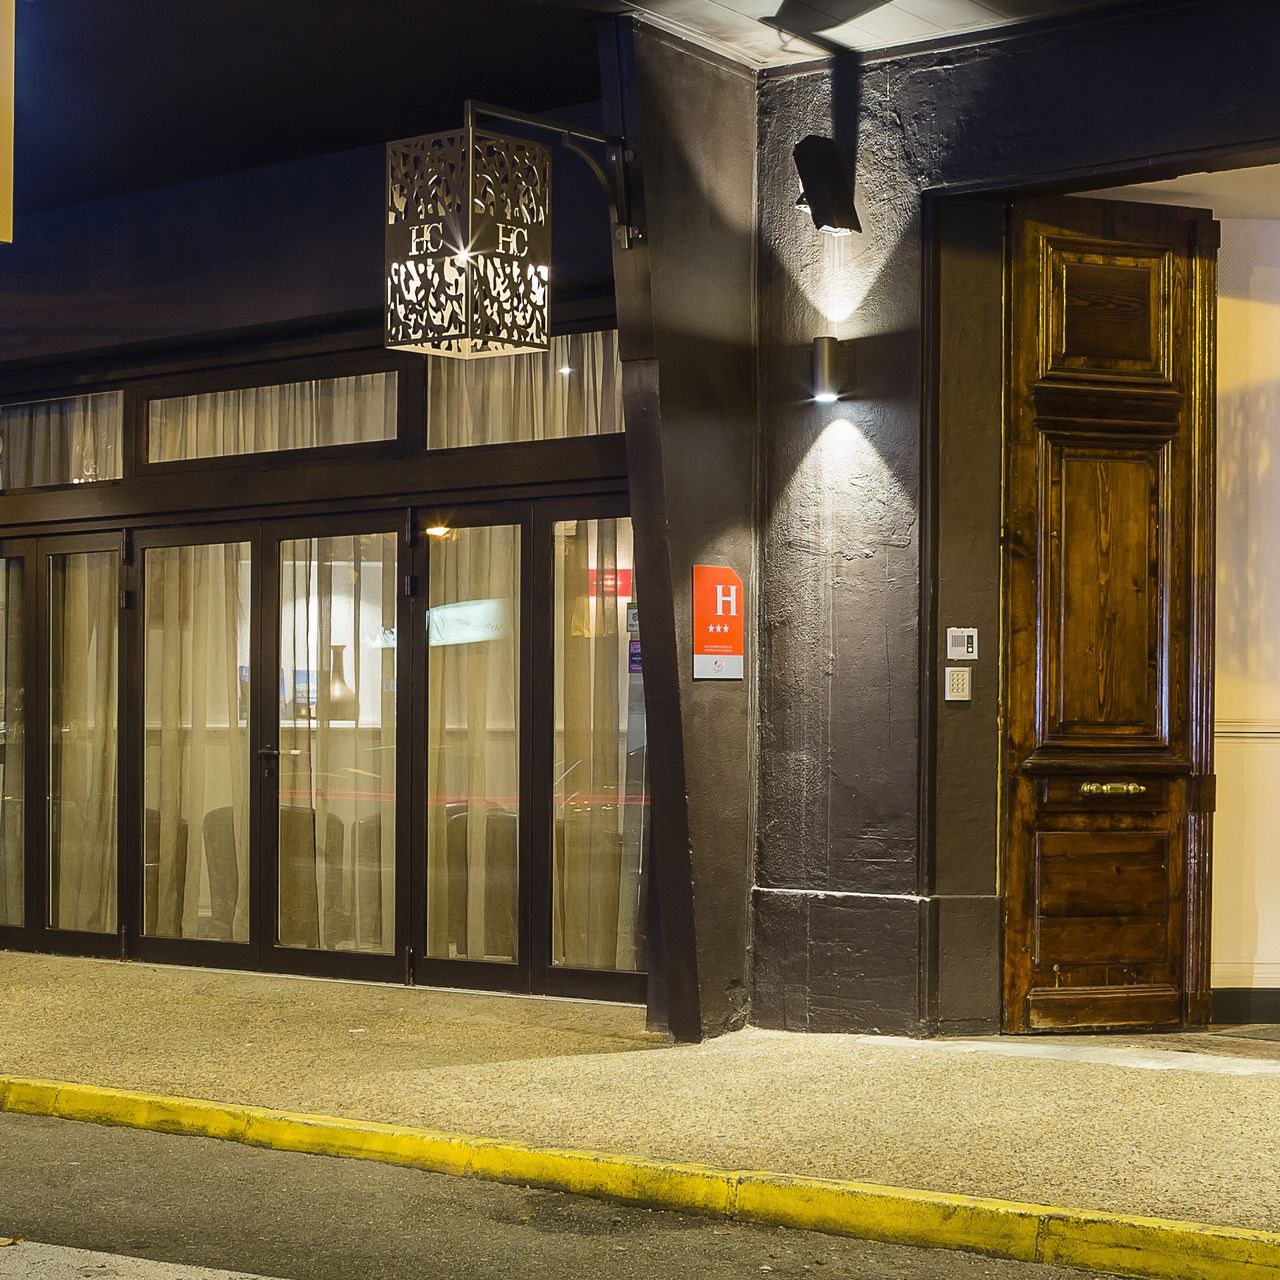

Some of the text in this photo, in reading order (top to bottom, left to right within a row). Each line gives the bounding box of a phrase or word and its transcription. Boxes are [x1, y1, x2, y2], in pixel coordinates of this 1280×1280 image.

[409, 222, 443, 257] HC
[496, 223, 528, 257] HC
[714, 584, 739, 616] H
